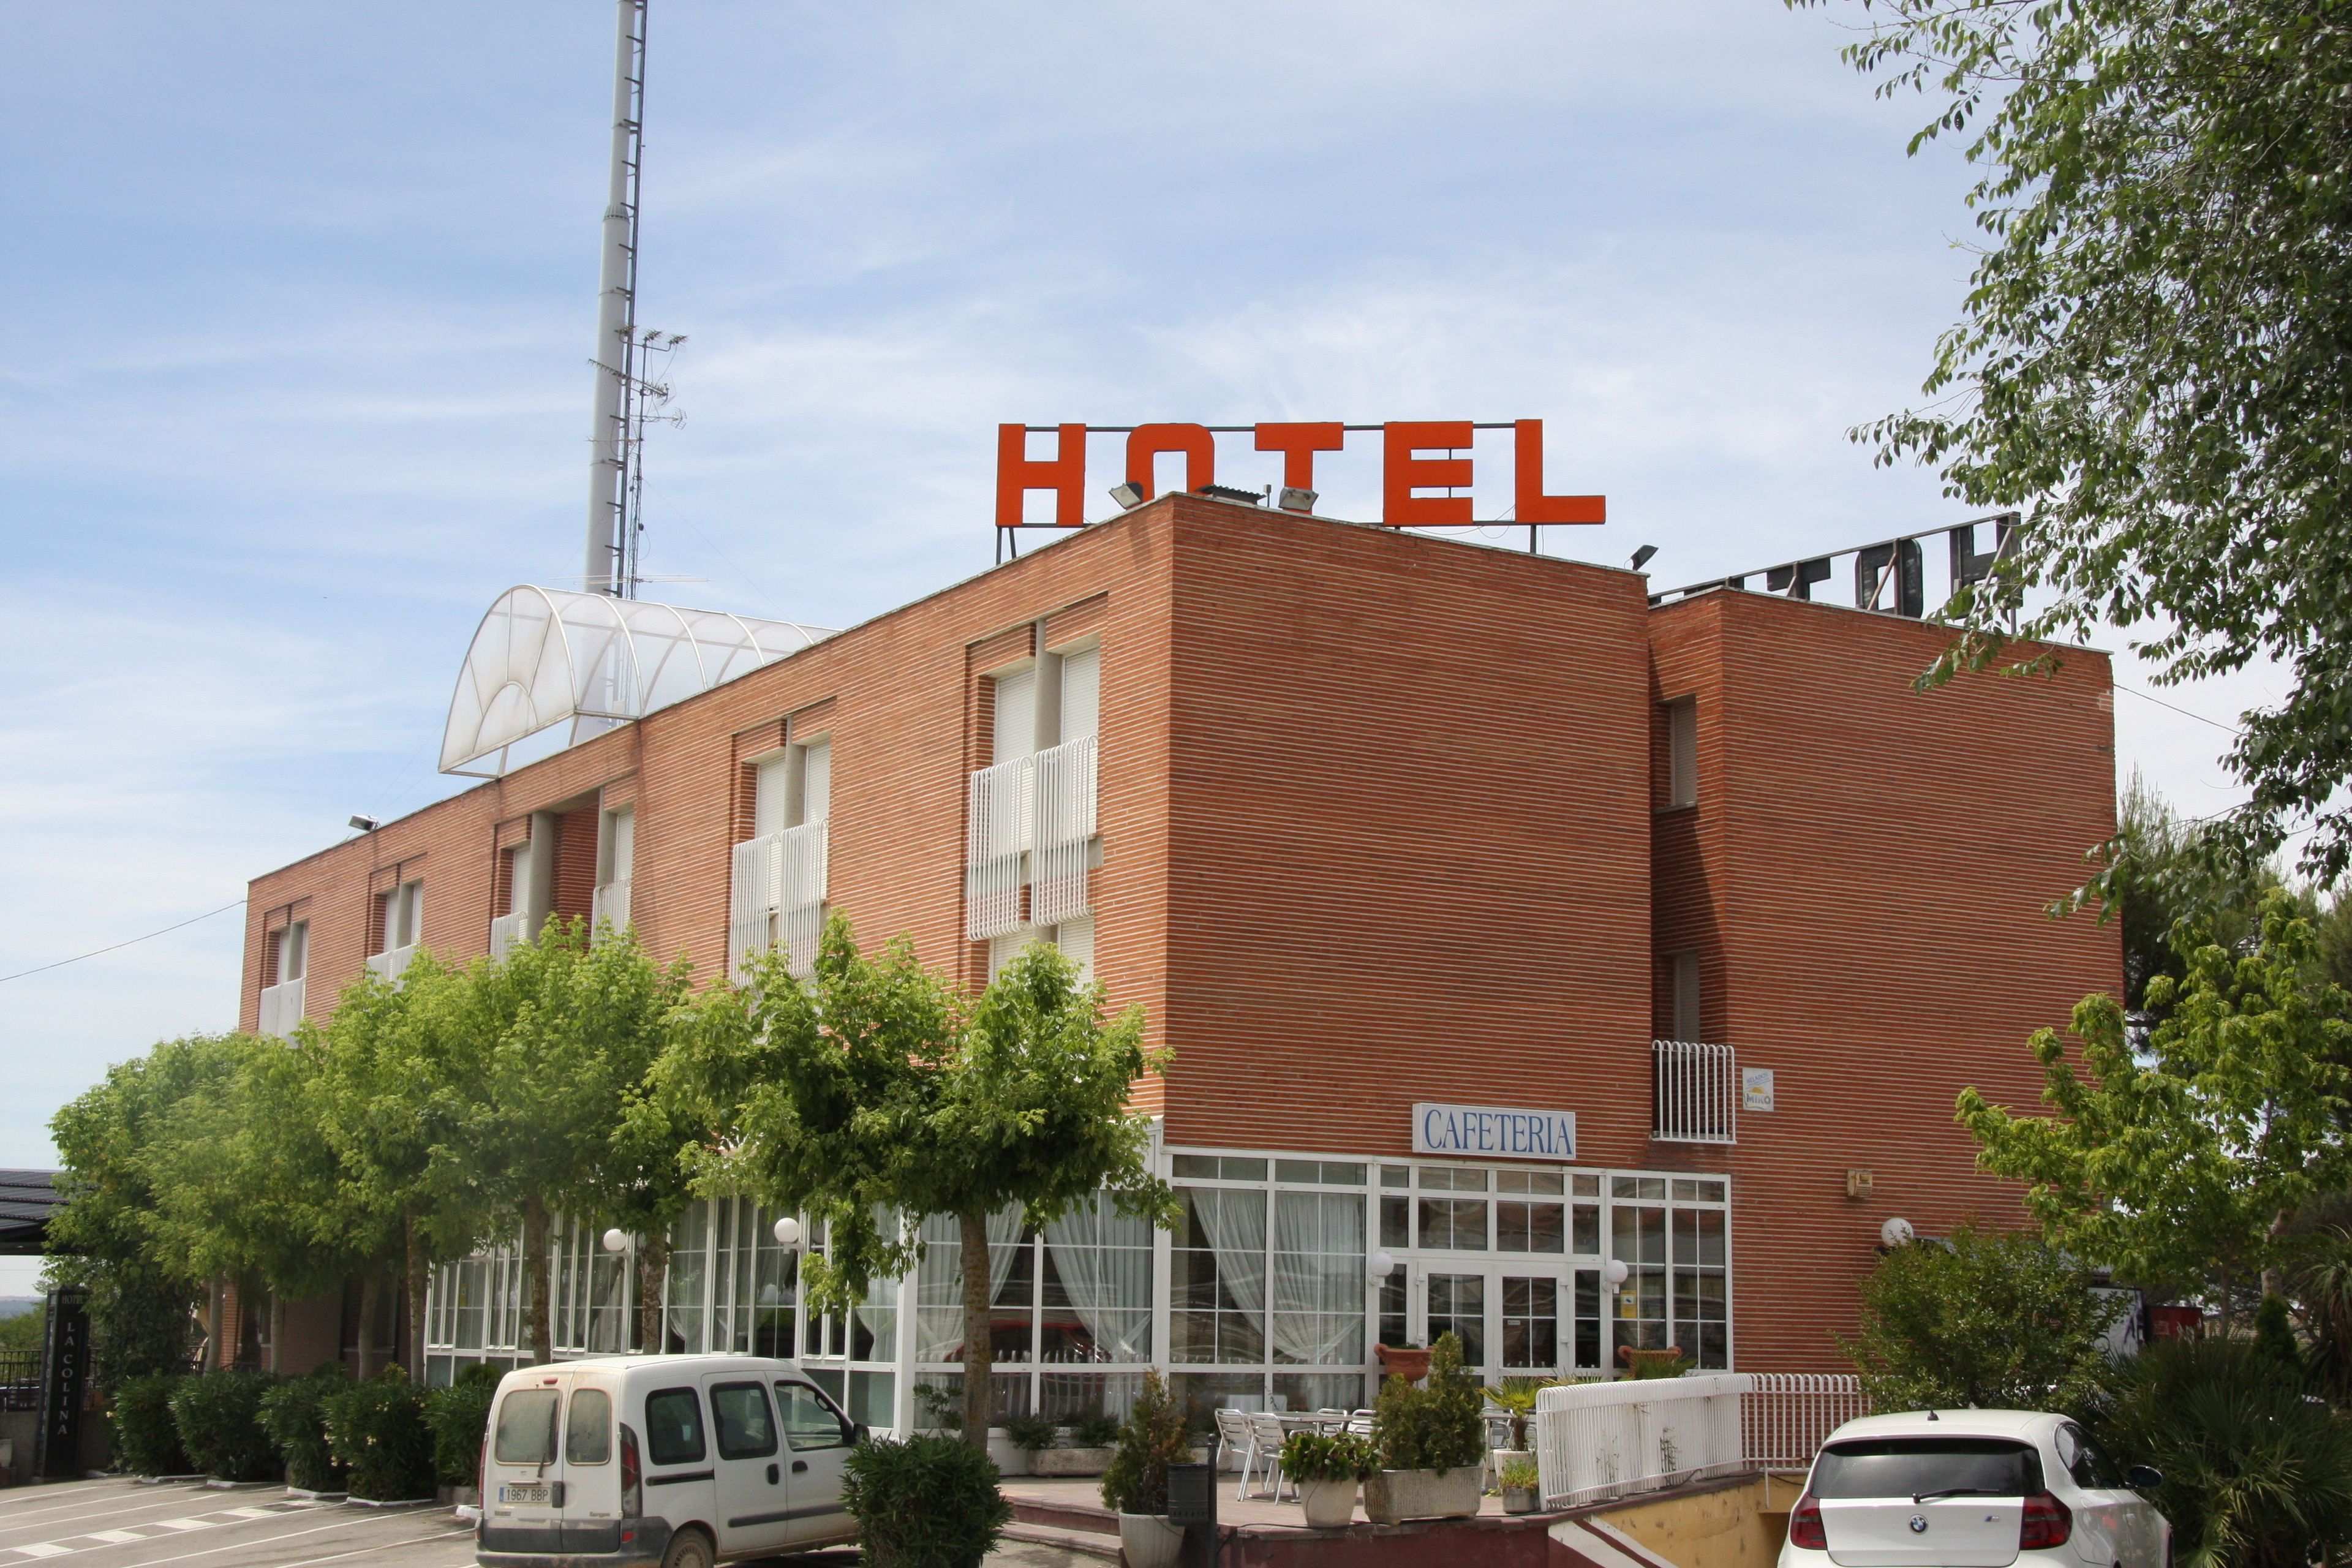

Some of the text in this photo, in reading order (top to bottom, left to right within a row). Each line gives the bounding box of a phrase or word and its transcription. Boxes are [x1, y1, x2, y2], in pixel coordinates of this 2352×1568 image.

[996, 419, 1605, 527] HOTEL
[1425, 1109, 1572, 1155] CAFETERIA
[58, 1322, 75, 1434] LA COLINA
[507, 1489, 548, 1501] 1967 BBP
